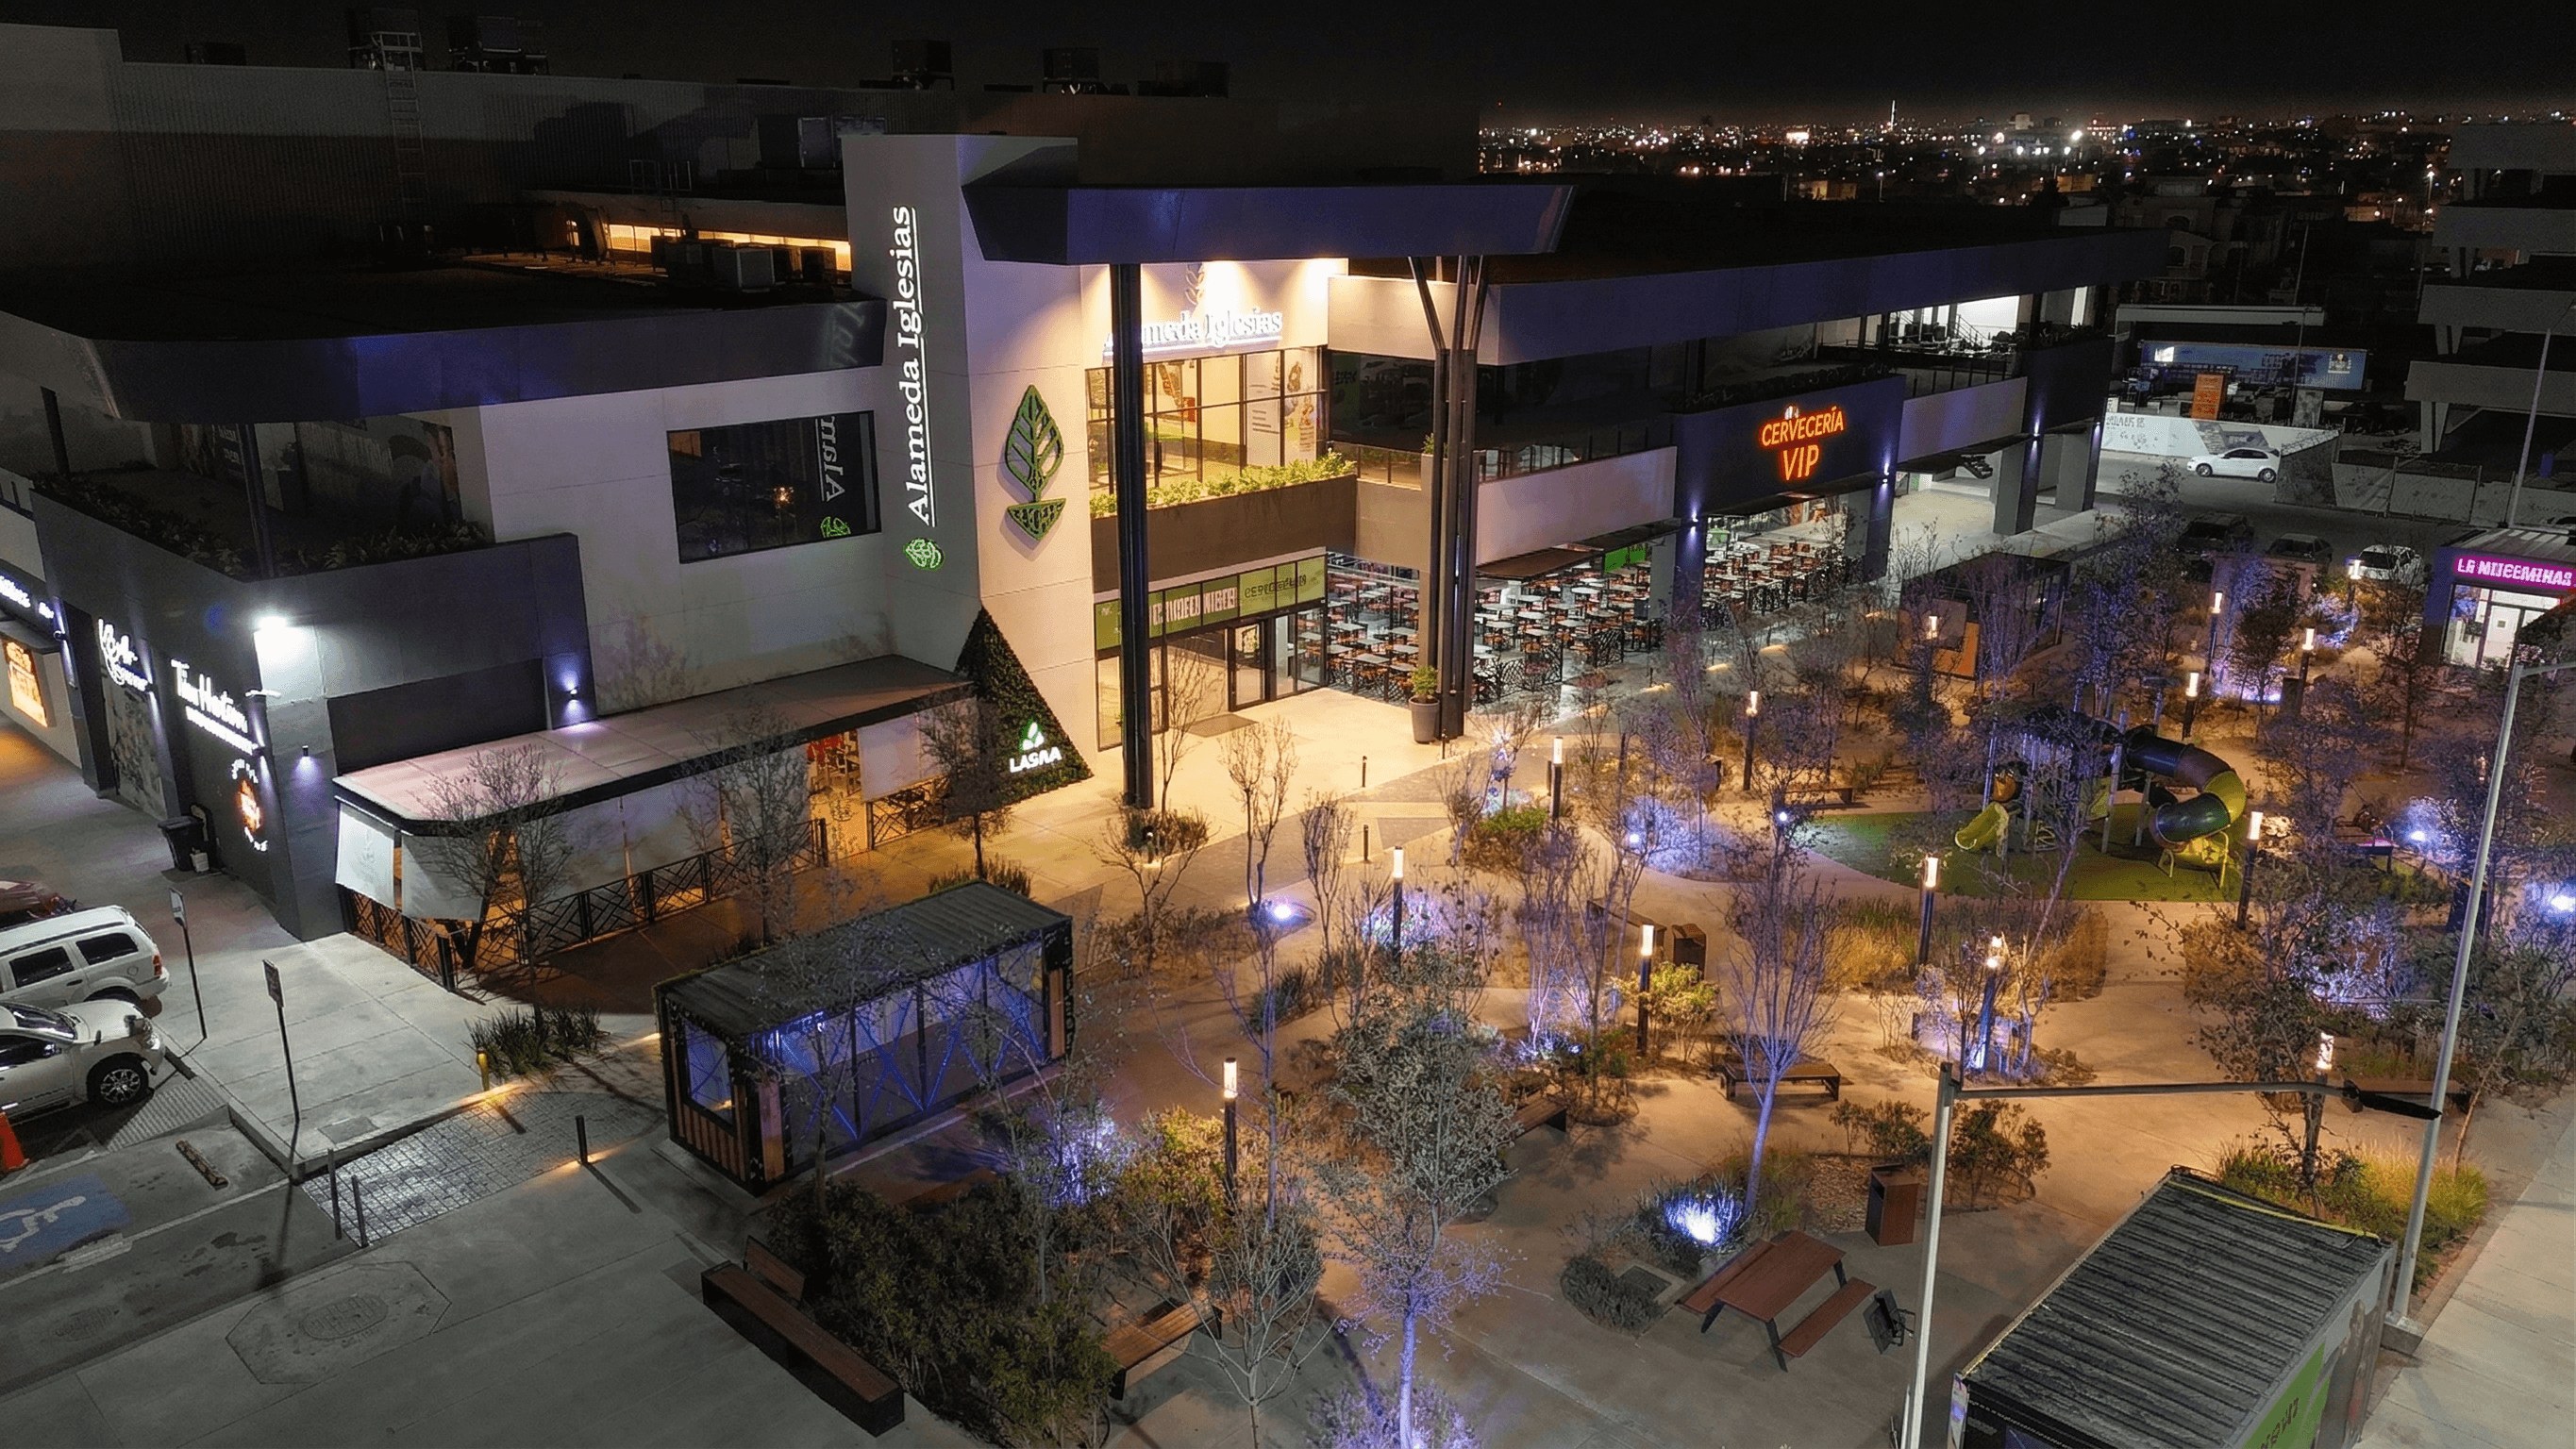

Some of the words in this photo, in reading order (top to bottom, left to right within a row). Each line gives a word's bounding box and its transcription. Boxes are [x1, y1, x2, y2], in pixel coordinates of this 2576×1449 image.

[889, 206, 922, 349] Iglesias
[899, 358, 929, 526] Alameda
[1761, 406, 1845, 447] CERVECERÍA
[1782, 444, 1820, 481] VIP
